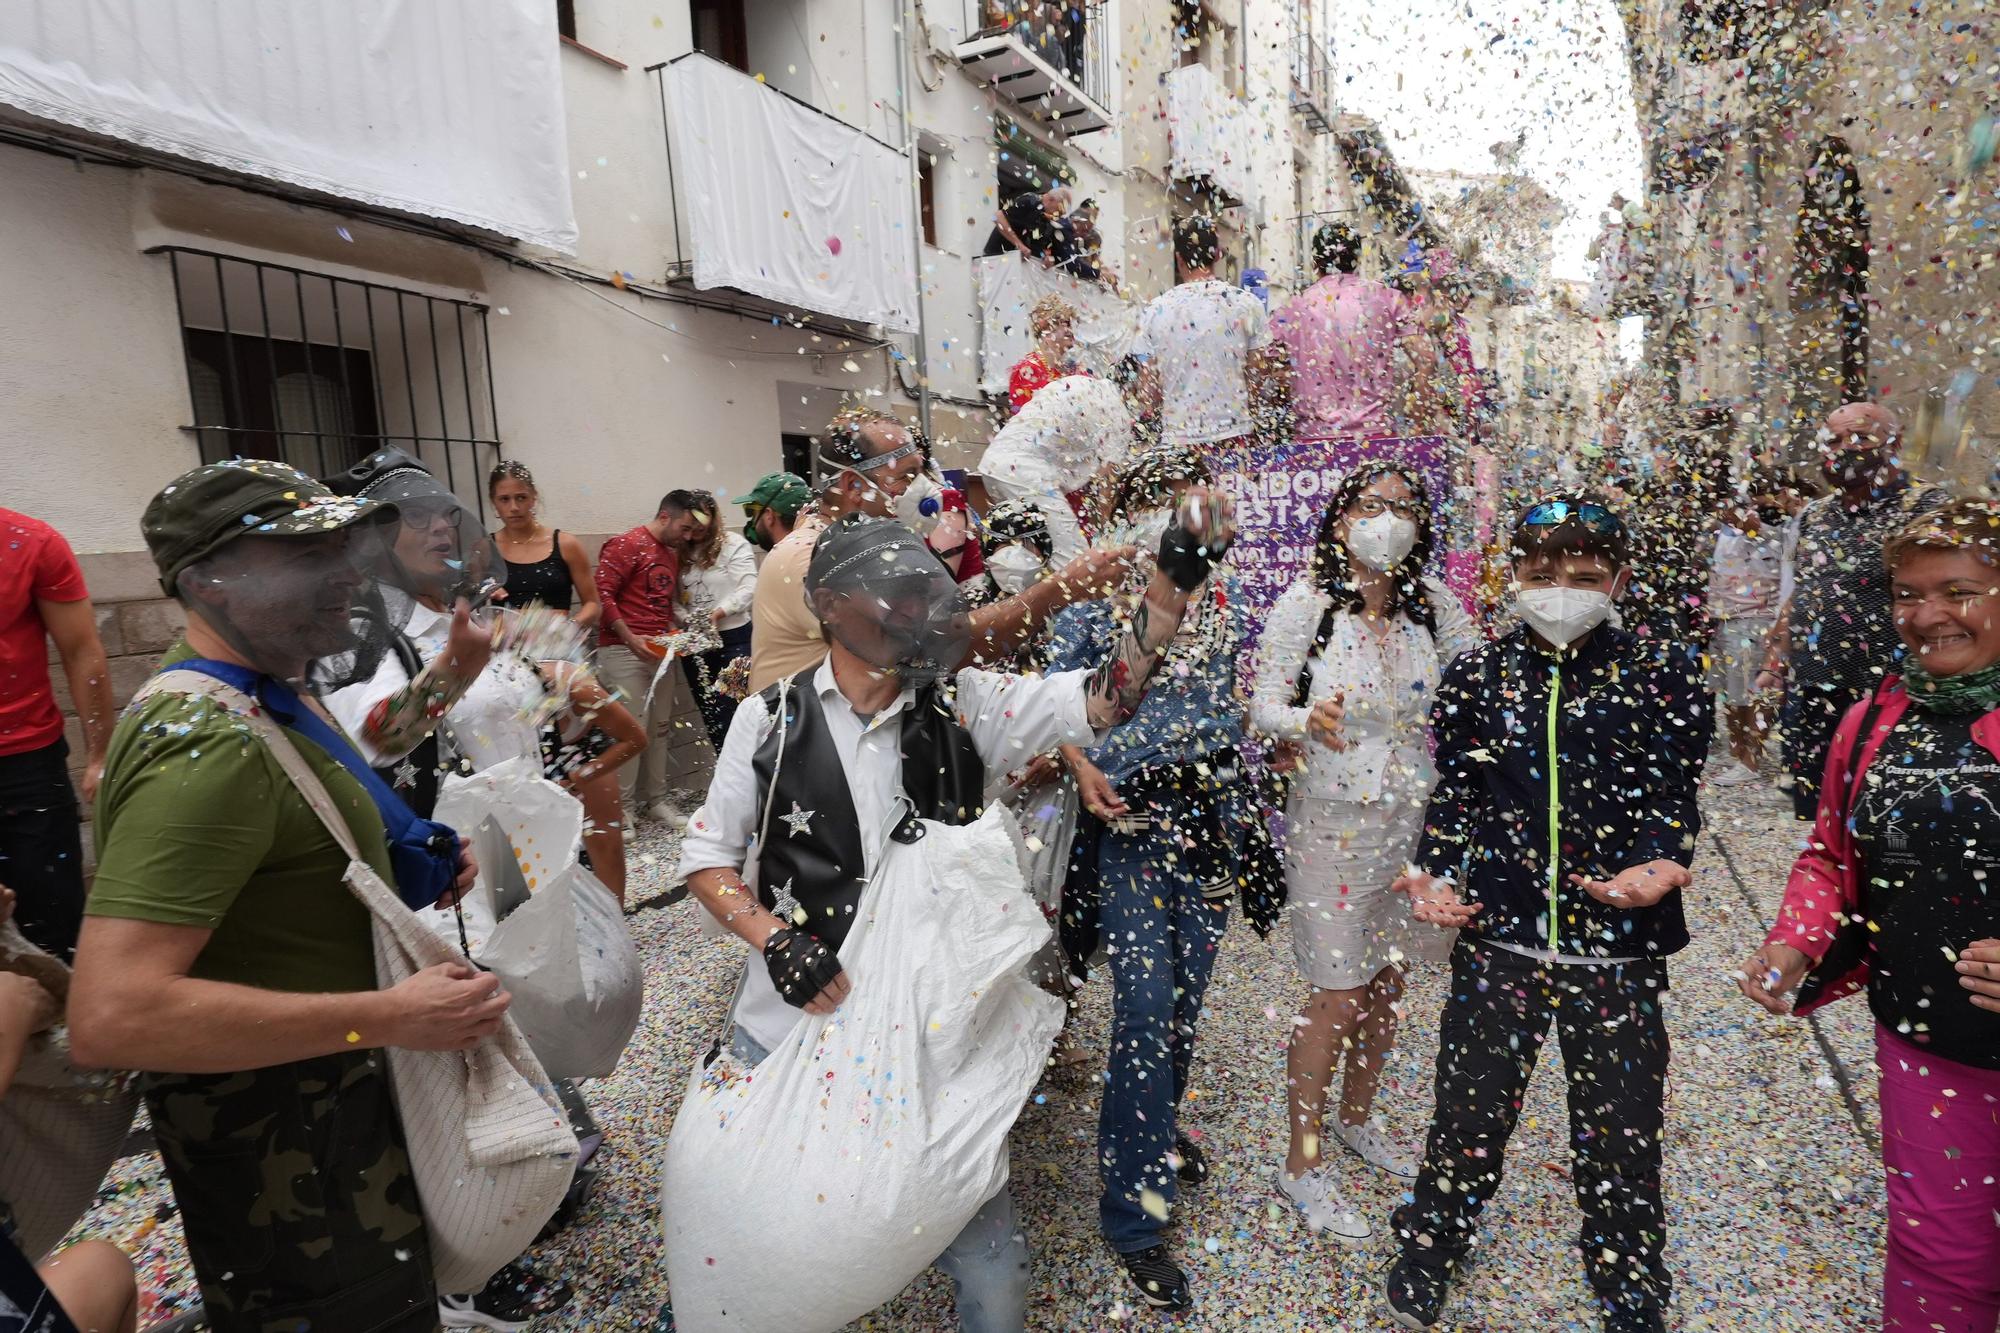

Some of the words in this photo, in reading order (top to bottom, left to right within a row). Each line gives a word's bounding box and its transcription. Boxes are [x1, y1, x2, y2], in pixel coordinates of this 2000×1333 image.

[1218, 468, 1344, 498] ENIDOR
[1235, 499, 1293, 526] EST
[1226, 547, 1270, 563] IVAL
[1936, 767, 1959, 777] por
